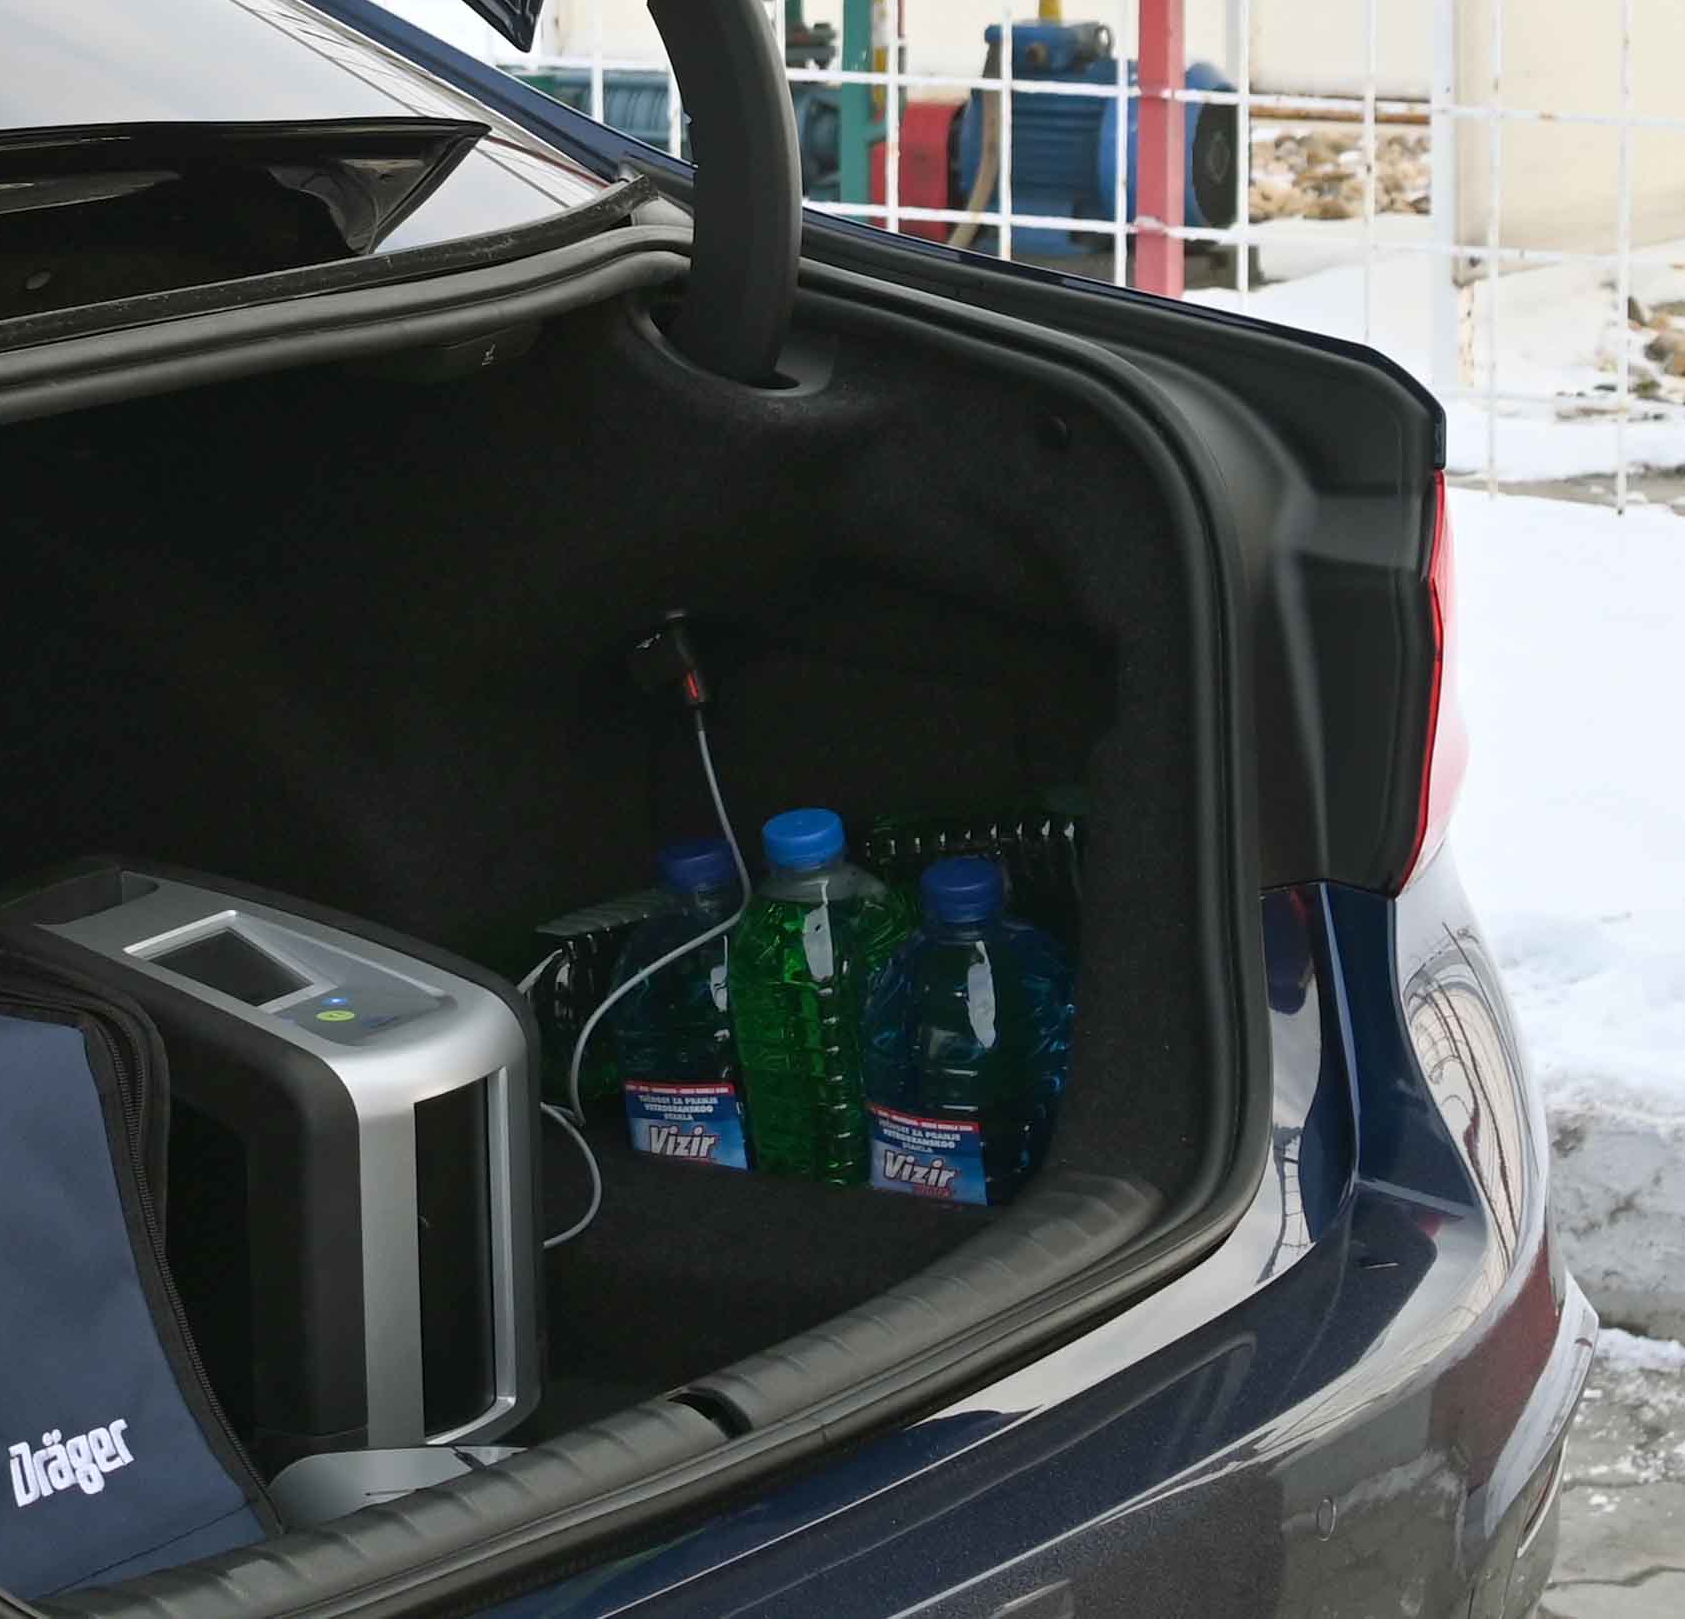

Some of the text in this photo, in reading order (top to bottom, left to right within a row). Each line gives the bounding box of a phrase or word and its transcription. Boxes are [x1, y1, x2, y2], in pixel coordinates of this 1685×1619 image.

[649, 1125, 716, 1158] Vizir
[884, 1150, 956, 1189] Vizir
[8, 1418, 135, 1508] Dräger
